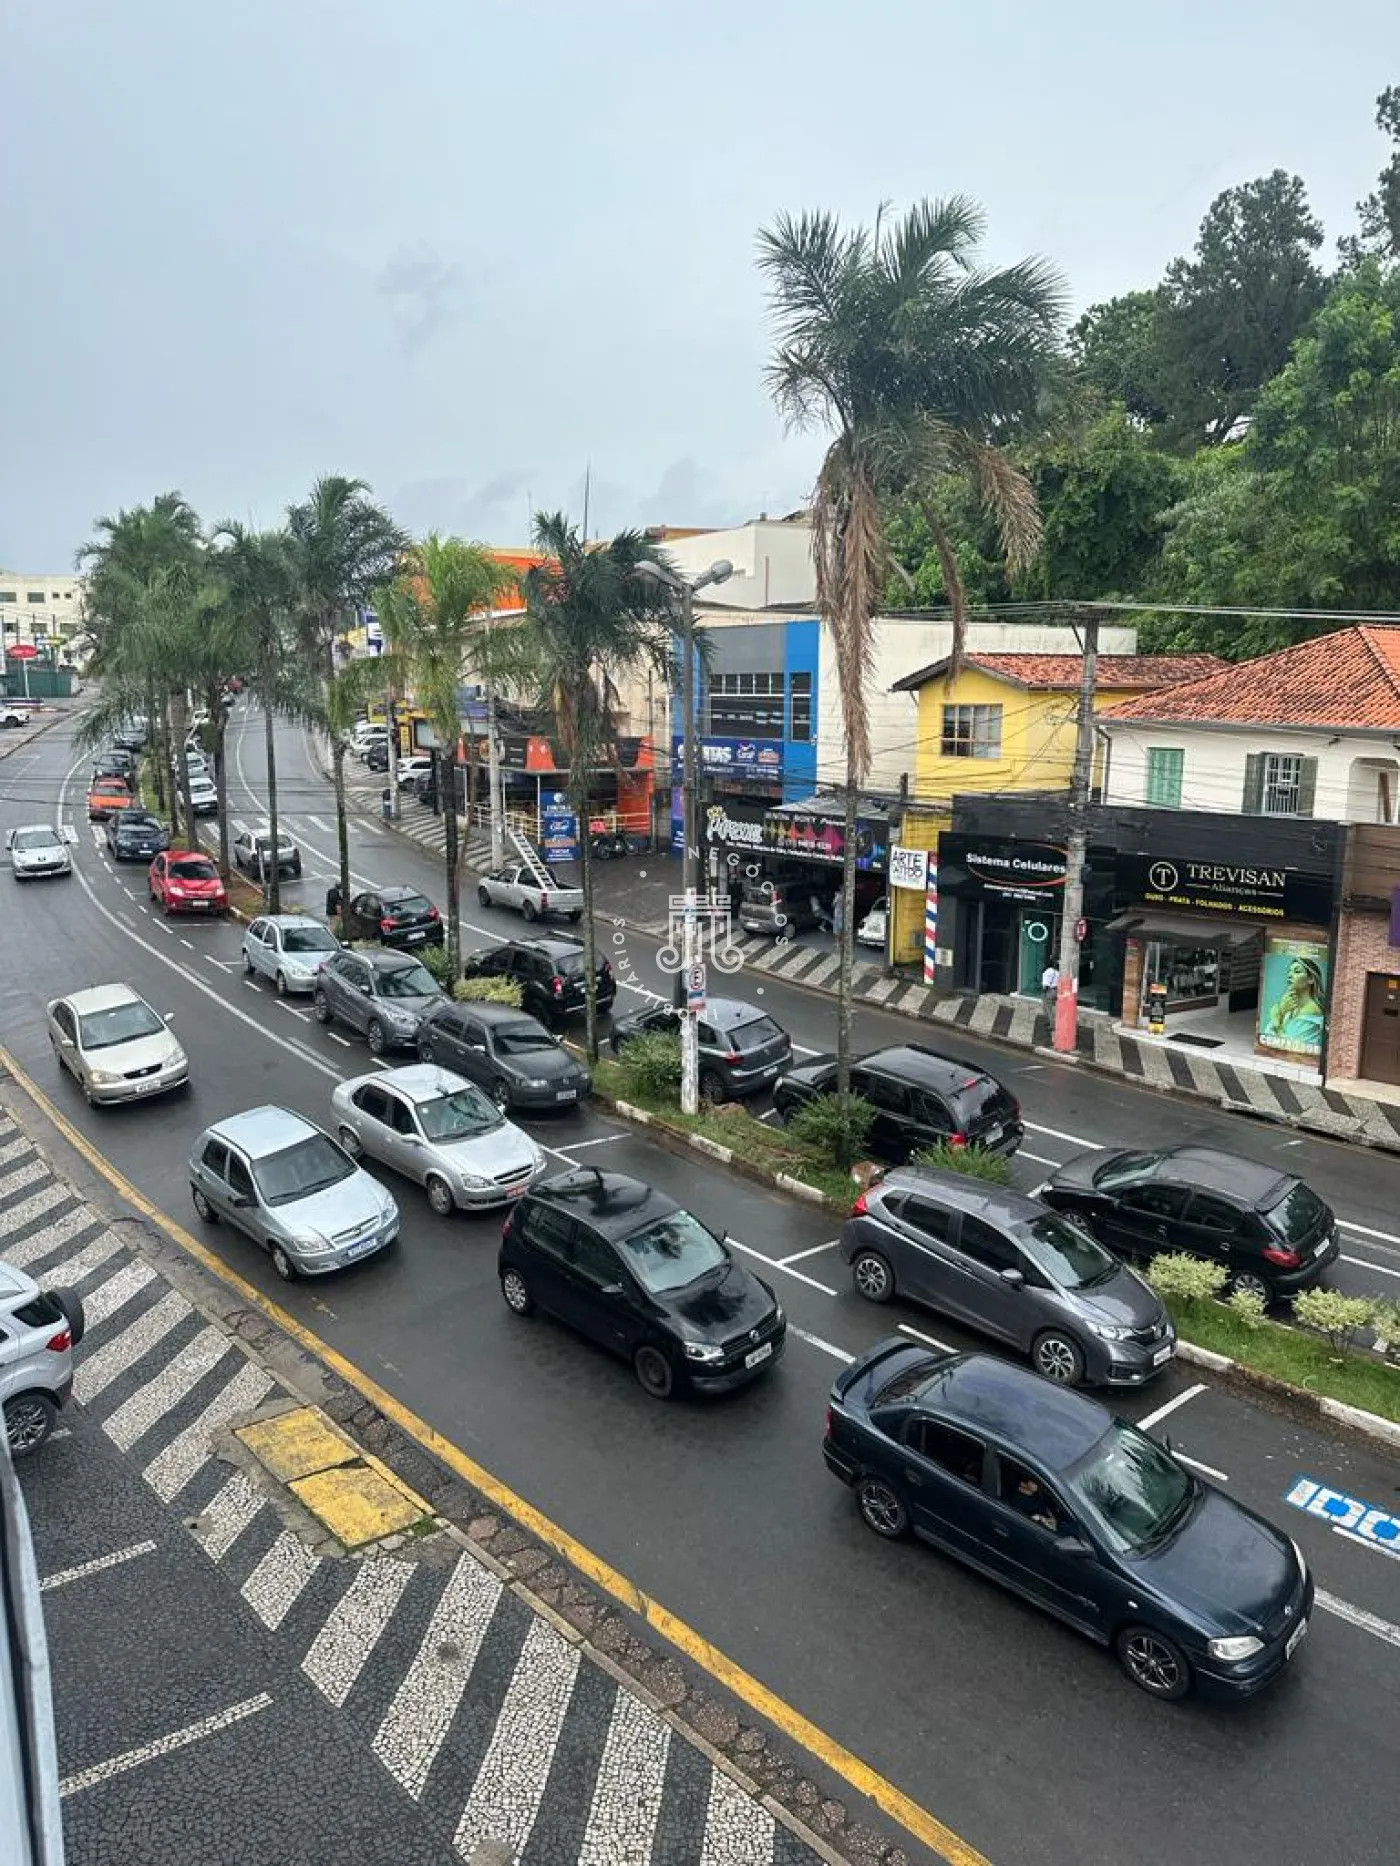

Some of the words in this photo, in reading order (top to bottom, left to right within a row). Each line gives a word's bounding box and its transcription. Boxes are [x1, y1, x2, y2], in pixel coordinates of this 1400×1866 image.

[966, 852, 1010, 868] Sistema
[1012, 857, 1066, 874] Celulares
[1186, 863, 1286, 887] TREVISAN
